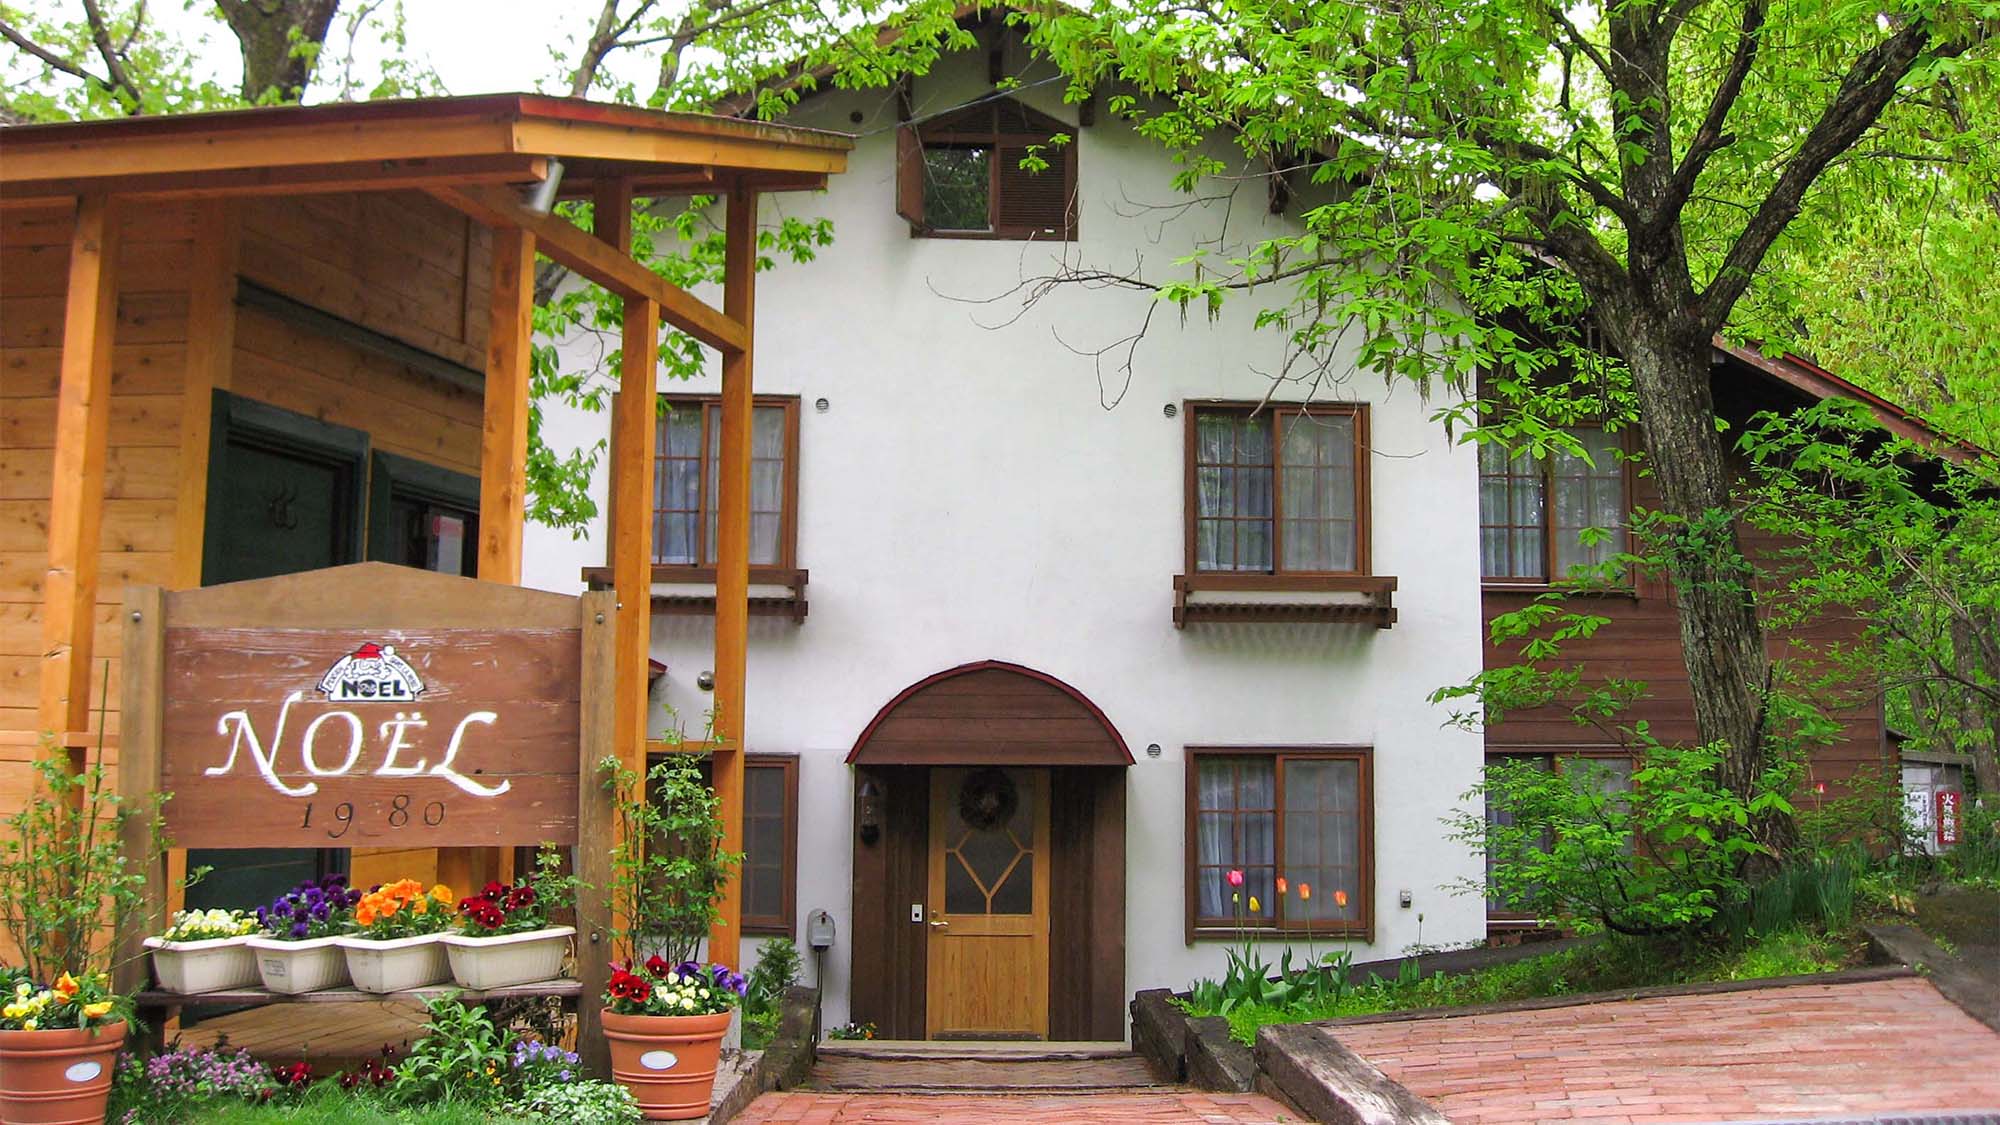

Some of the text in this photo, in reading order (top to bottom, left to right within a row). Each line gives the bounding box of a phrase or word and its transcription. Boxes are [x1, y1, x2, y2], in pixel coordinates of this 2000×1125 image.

[341, 679, 406, 698] NOEL
[204, 690, 512, 797] NOËL
[300, 794, 446, 838] 1980
